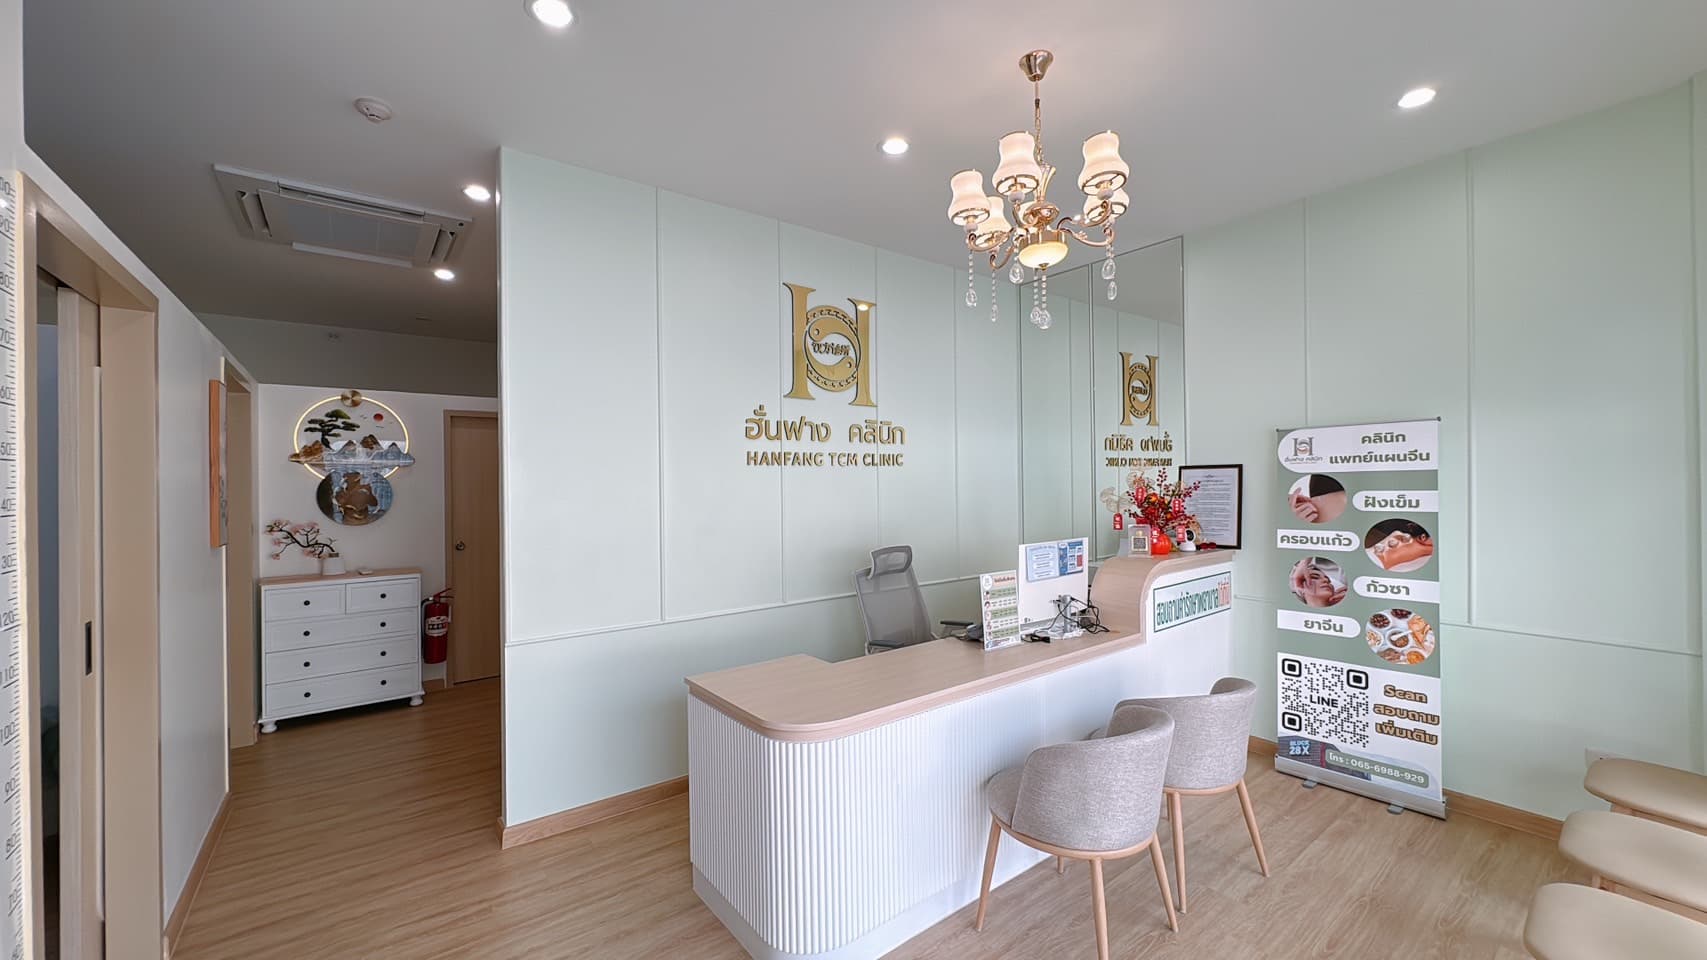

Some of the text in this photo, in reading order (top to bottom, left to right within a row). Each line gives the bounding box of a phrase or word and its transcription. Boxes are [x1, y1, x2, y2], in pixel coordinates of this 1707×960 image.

[745, 404, 906, 445] ฮั่นฟาง คลินิก
[1361, 432, 1406, 444] คลินิก
[746, 451, 904, 467] HANFANG TCM CLINIC
[1329, 449, 1430, 464] แพทย์แผนจีน
[1364, 494, 1420, 509] ฝังเข็ม
[1280, 533, 1353, 547] ครอบแก้ว
[1366, 580, 1410, 596] กัวซา
[1304, 617, 1344, 633] ยาจีน
[1309, 694, 1339, 709] LINE
[1384, 684, 1428, 704] Scan
[1373, 703, 1440, 726] สอบถาม
[1375, 719, 1438, 746] เพิ่มเติม
[1350, 758, 1425, 784] 065-6988-929
